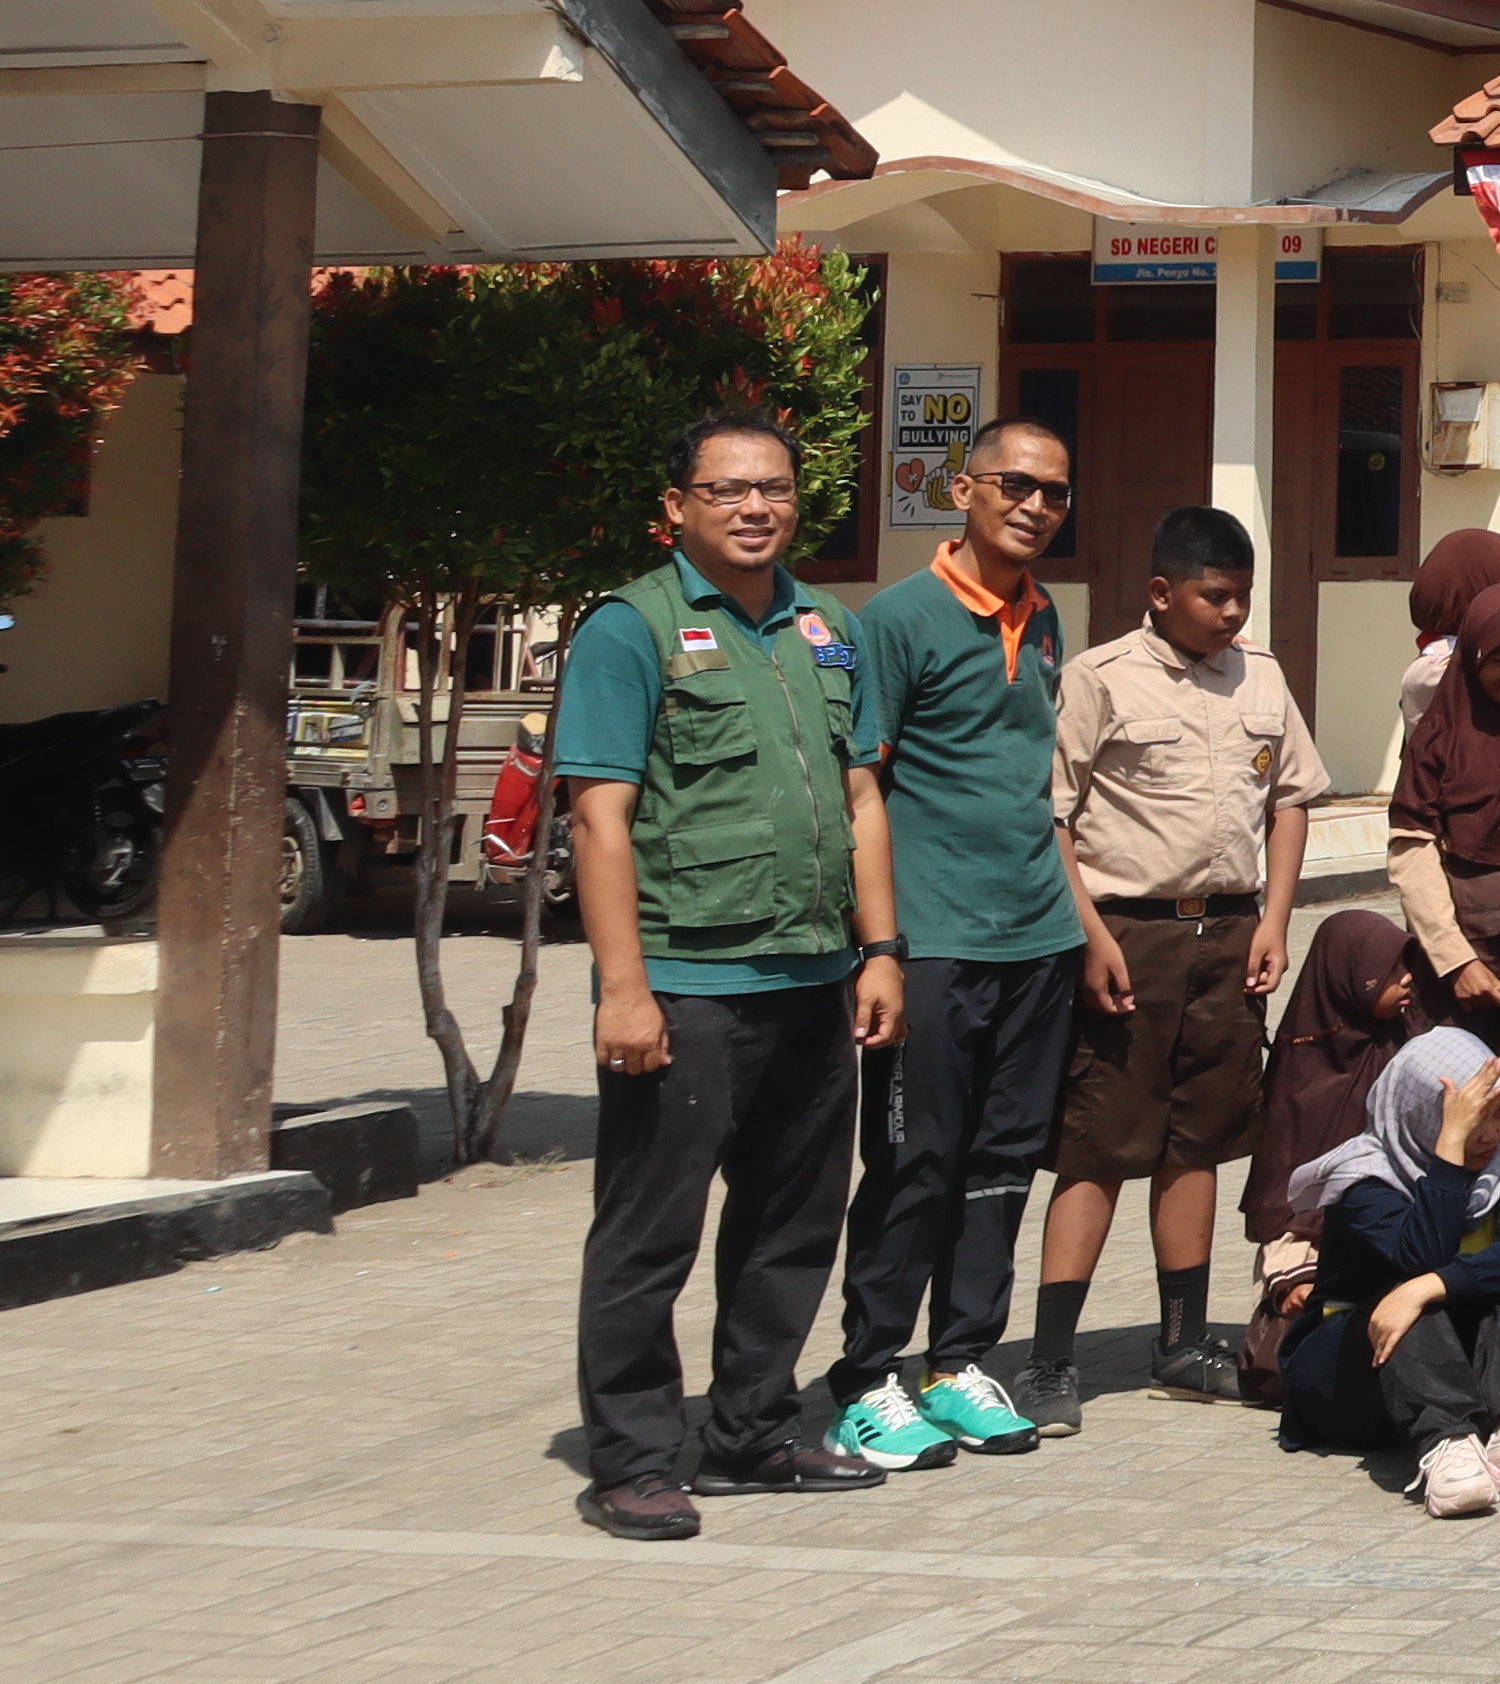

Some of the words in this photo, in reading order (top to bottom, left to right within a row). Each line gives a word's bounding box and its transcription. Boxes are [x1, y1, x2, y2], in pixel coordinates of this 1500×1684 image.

[1111, 239, 1132, 255] SD
[1137, 237, 1199, 255] NEGERI
[1282, 235, 1302, 253] 09
[901, 395, 922, 406] SAY
[924, 393, 971, 424] NO
[901, 410, 916, 421] TO
[902, 430, 969, 444] BULLYING
